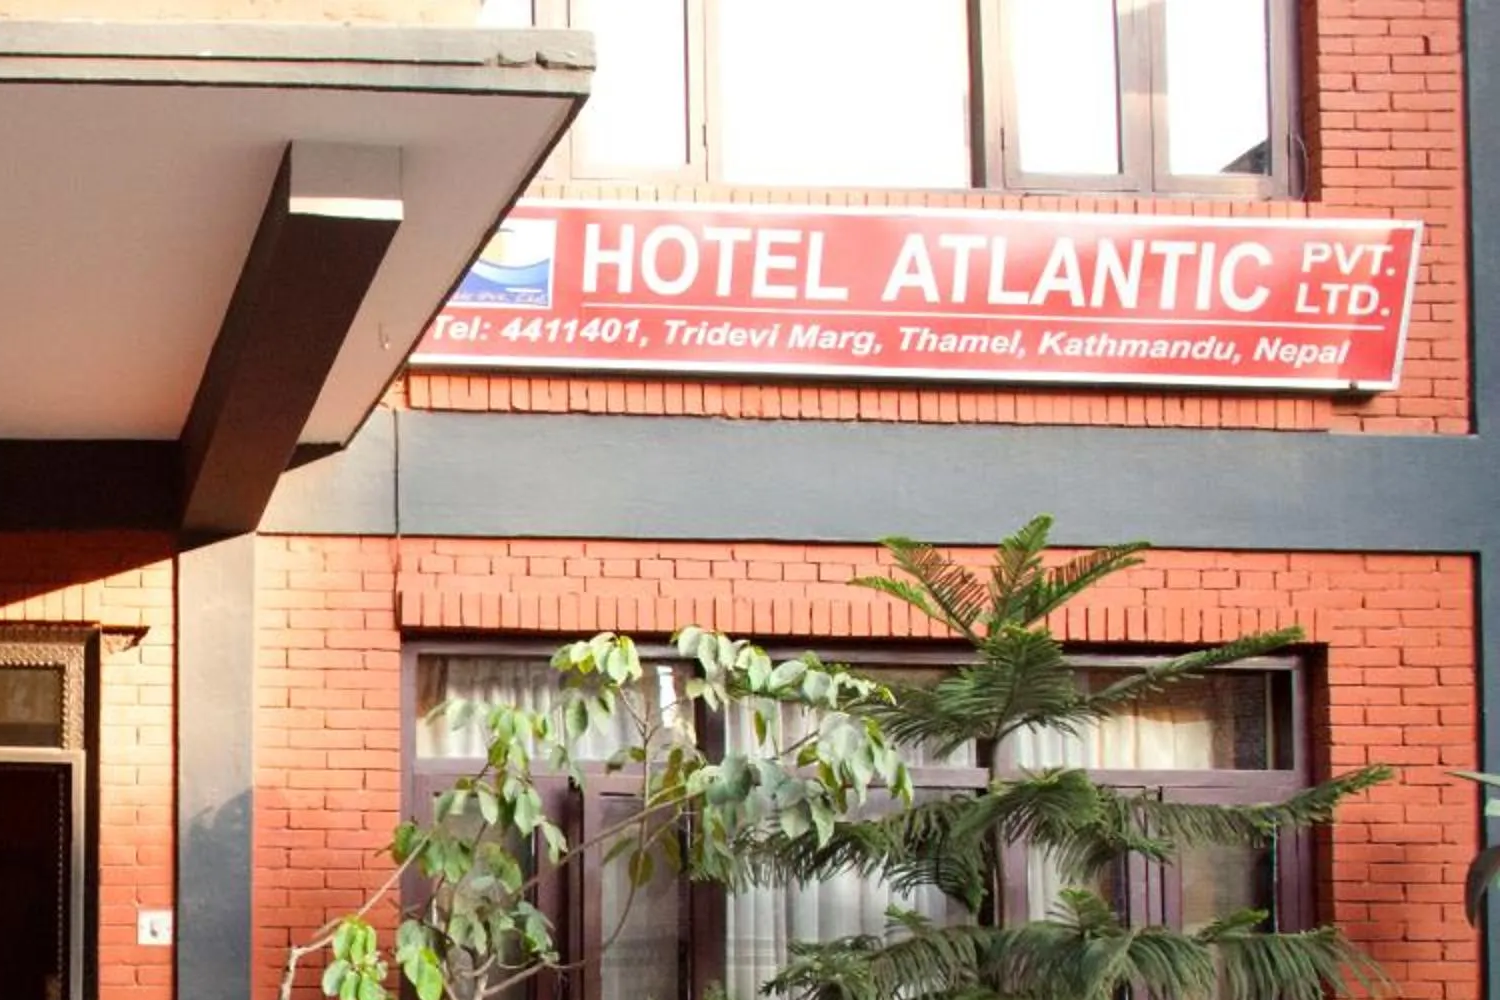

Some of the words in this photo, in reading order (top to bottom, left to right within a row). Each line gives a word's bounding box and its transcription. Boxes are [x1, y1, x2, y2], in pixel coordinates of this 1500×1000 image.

[581, 223, 848, 301] HOTEL
[881, 234, 1273, 312] ATLANTIC
[1302, 242, 1396, 277] PVT.
[1295, 281, 1391, 316] LTD.
[432, 315, 492, 341] Tel:
[501, 316, 649, 348] 4411401,
[664, 319, 779, 348] Tridevi
[787, 325, 883, 355] Marg,
[899, 327, 1026, 358] Thamel,
[1038, 332, 1243, 365] Kathmandu,
[1253, 338, 1350, 367] Nepal
